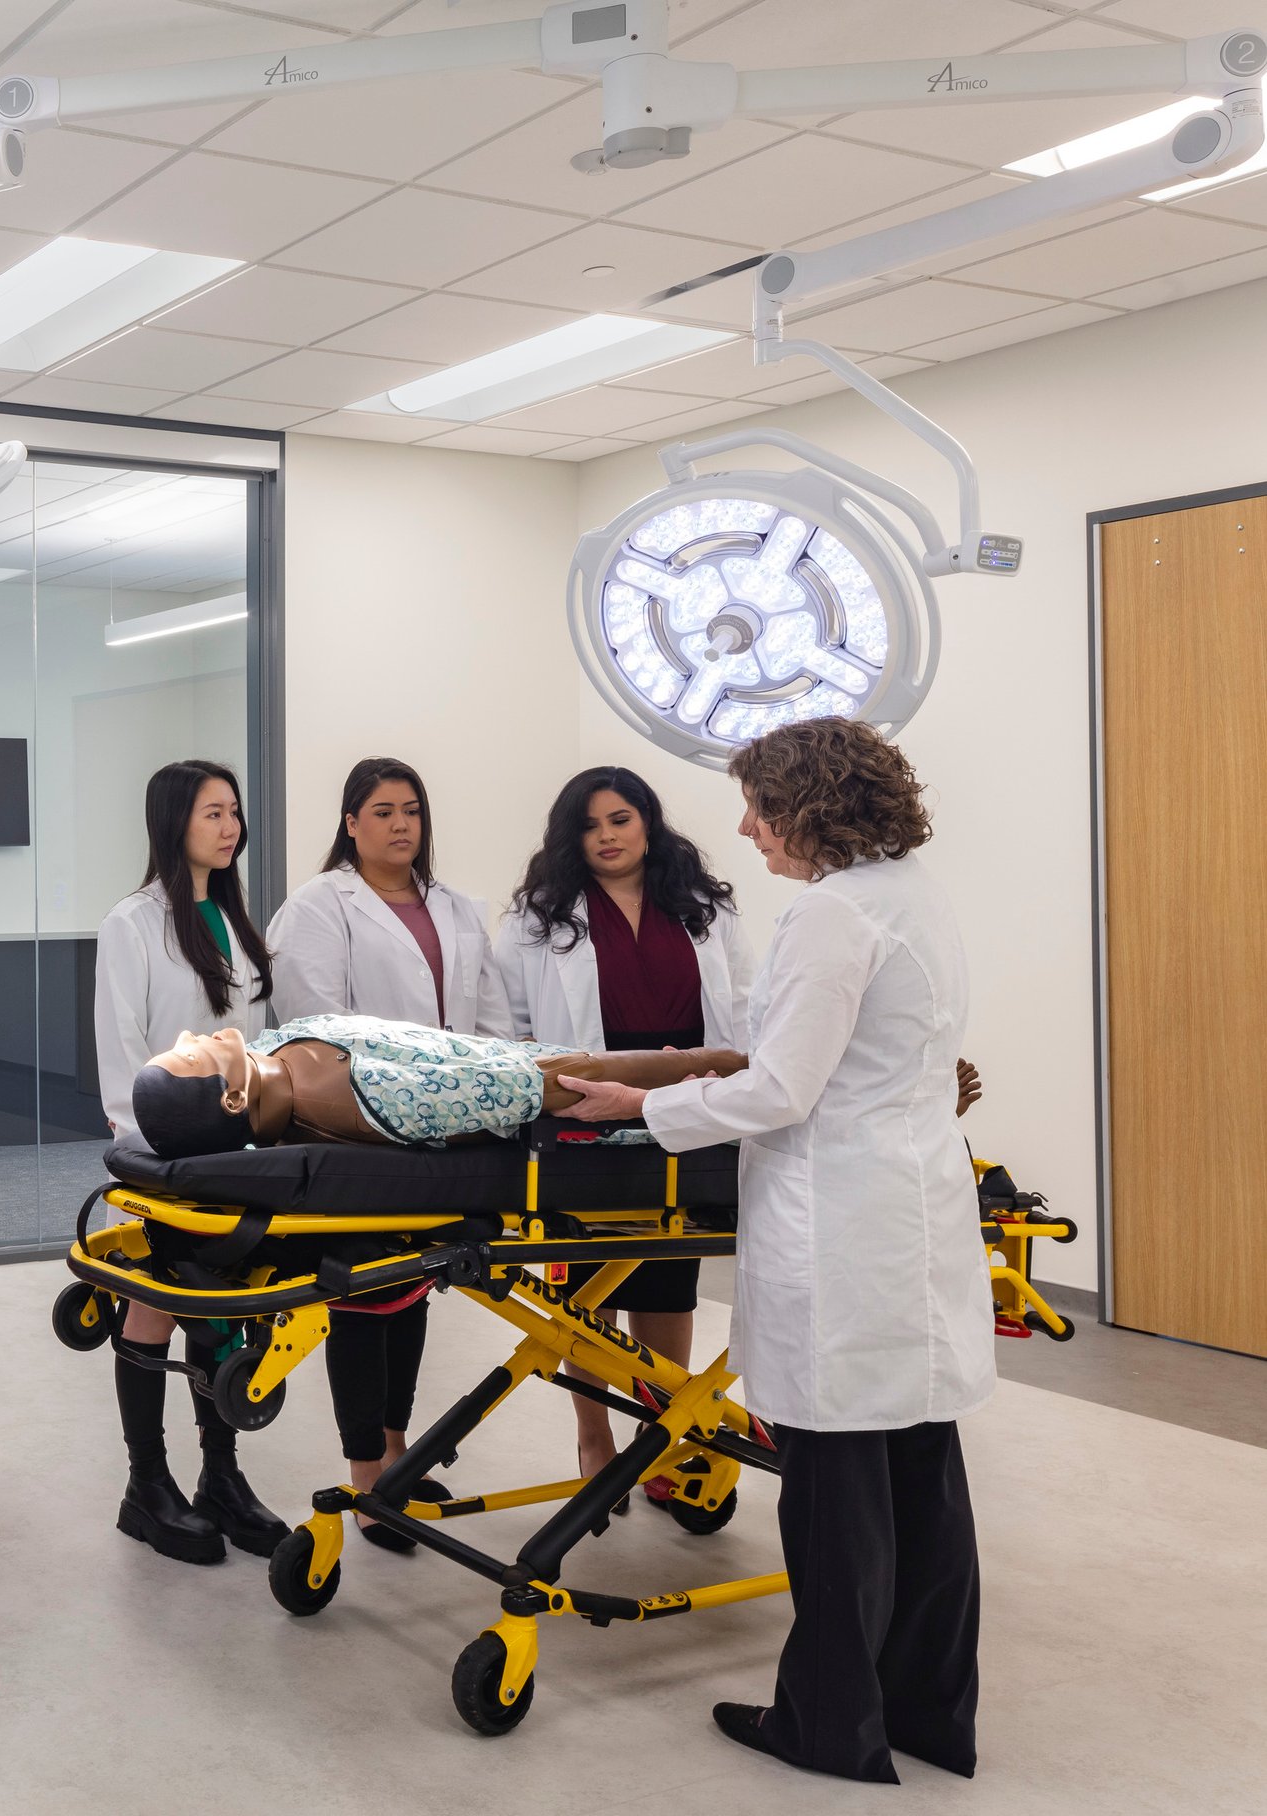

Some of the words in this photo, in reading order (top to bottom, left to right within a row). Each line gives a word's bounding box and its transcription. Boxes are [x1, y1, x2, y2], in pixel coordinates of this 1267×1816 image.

[1238, 40, 1255, 64] 2
[264, 55, 319, 85] Amico
[927, 61, 988, 92] Amico
[8, 87, 17, 108] 1
[125, 1200, 150, 1213] RUGGED
